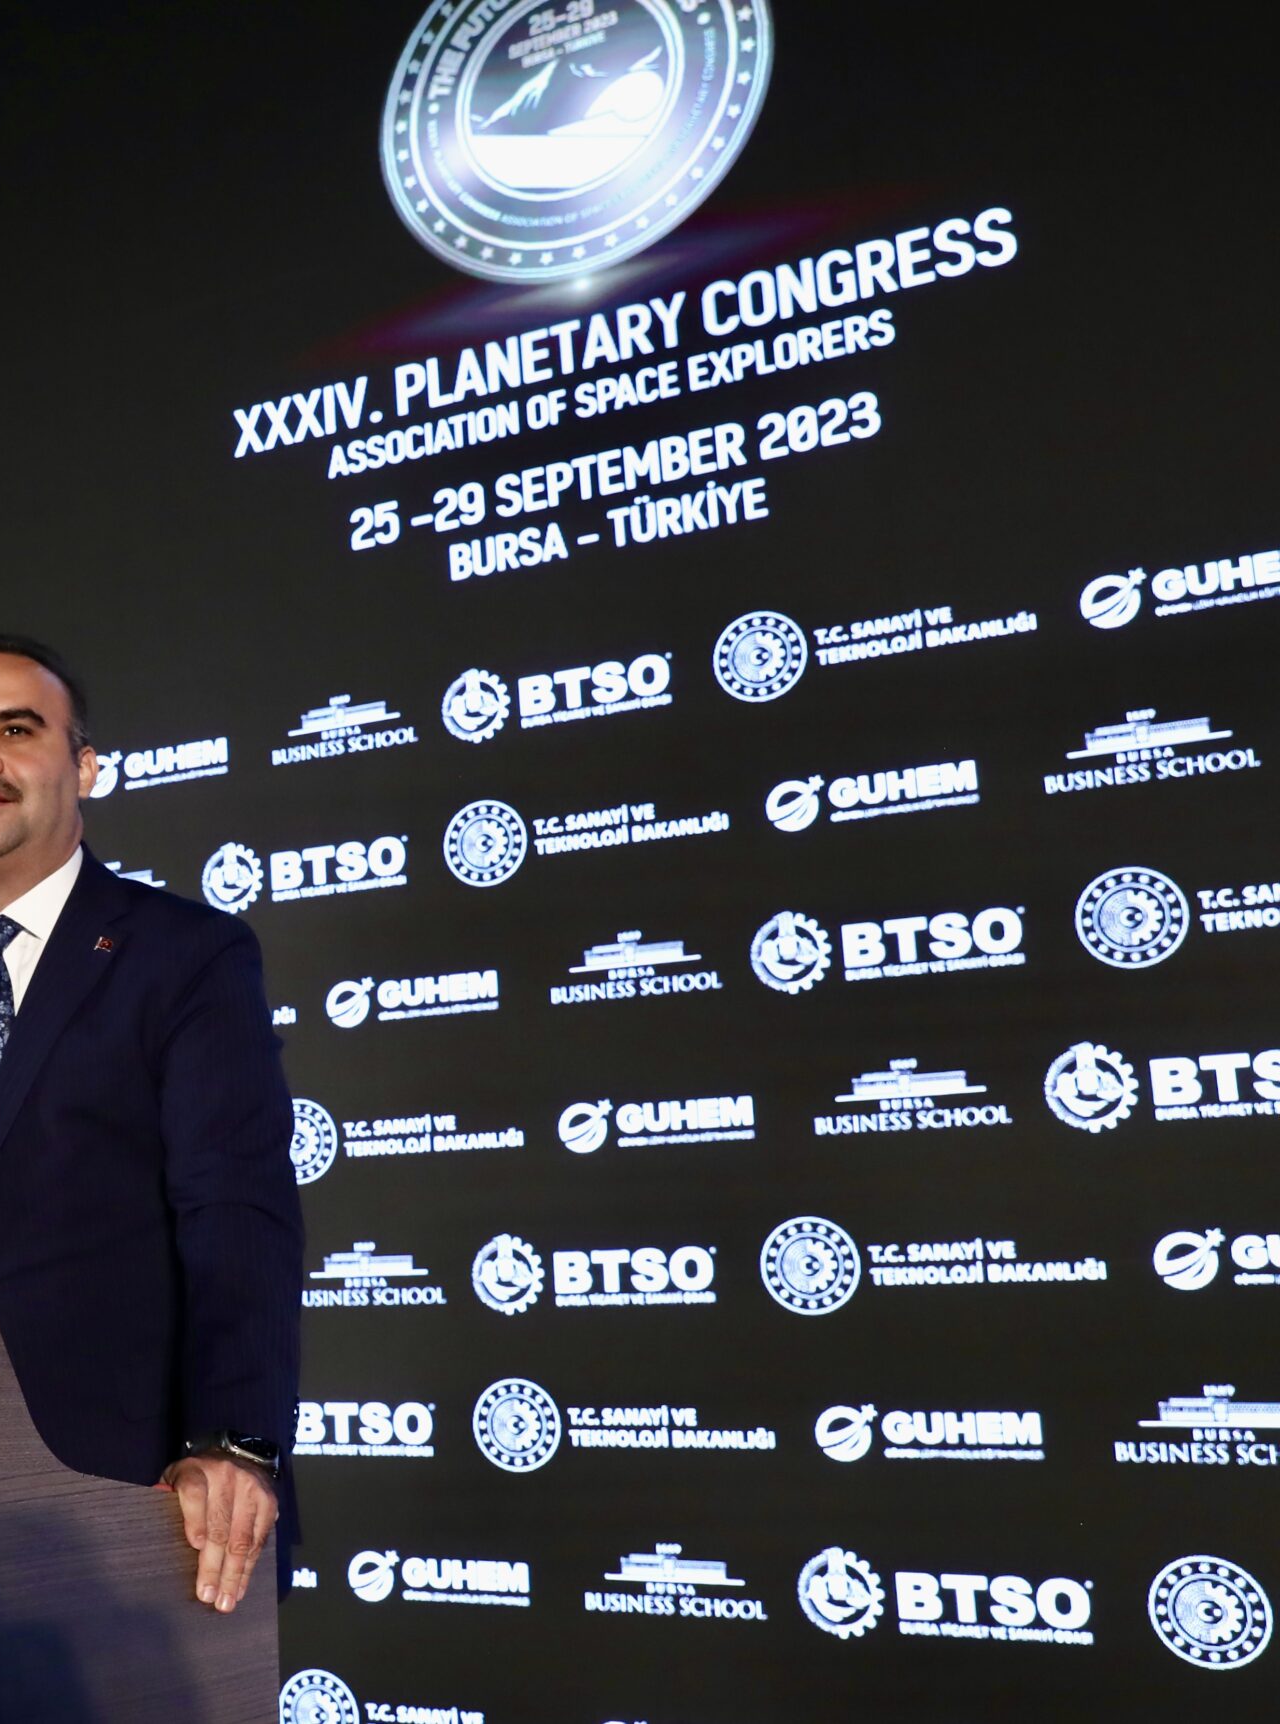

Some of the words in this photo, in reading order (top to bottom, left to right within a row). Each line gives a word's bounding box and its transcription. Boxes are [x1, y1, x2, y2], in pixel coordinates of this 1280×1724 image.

[233, 377, 383, 458] XXXIV.
[395, 291, 686, 417] PLANETARY
[702, 207, 1019, 338] CONGRESS
[326, 404, 520, 480] ASSOCIATION
[526, 388, 567, 431] OF
[574, 362, 680, 419] SPACE
[687, 308, 895, 393] EXPLORERS
[349, 499, 400, 552] 25
[495, 421, 746, 519] SEPTEMBER
[758, 391, 882, 463] 2023
[448, 522, 568, 582] BURSA
[607, 478, 770, 548] TÜRKİYE
[1151, 549, 1280, 602] GUHE
[814, 625, 849, 645] T.C.
[851, 609, 922, 640] SANAYİ
[924, 606, 952, 626] VE
[815, 630, 923, 666] TEKNOLOJİ
[925, 611, 1038, 648] BAKANLIĞI
[518, 654, 671, 718] BTSO
[124, 736, 229, 779] GUHEM
[272, 737, 346, 766] BUSINESS
[348, 726, 419, 754] SCHOOL
[1116, 746, 1175, 764] BURSA
[828, 759, 979, 808] GUHEM
[1044, 763, 1151, 795] BUSINESS
[1155, 748, 1262, 780] SCHOOL
[533, 816, 564, 836] T.C.
[565, 804, 629, 832] SANAYİ
[630, 803, 656, 822] VE
[534, 825, 629, 855] TEKNOLOJİ
[632, 811, 730, 843] BAKANLIĞI
[270, 836, 407, 892] BTSO
[1197, 887, 1241, 910] T.C.
[841, 907, 1023, 969] BTSO
[1200, 907, 1280, 933] TEKNO
[377, 970, 498, 1009] GUHEM
[550, 977, 635, 1006] BUSINESS
[640, 971, 723, 998] SCHOOL
[608, 966, 656, 980] BURSA
[1148, 1048, 1280, 1106] BTS
[616, 1095, 755, 1134] GUHEM
[814, 1111, 912, 1136] BUSINESS
[917, 1105, 1013, 1129] SCHOOL
[879, 1097, 935, 1112] BURSA
[342, 1119, 372, 1138] T.C.
[433, 1114, 456, 1131] VE
[433, 1126, 525, 1153] BAKANLIĞI
[867, 1243, 905, 1263] T.C.
[907, 1237, 985, 1262] SANAYİ
[986, 1240, 1016, 1260] VE
[552, 1245, 715, 1295] BTSO
[869, 1260, 985, 1286] TEKNOLOJİ
[987, 1257, 1108, 1283] BAKANLIĞI
[301, 1289, 369, 1308] USINESS
[372, 1286, 448, 1306] SCHOOL
[295, 1401, 434, 1446] BTSO
[567, 1407, 600, 1426] T.C.
[601, 1404, 669, 1427] SANAYİ
[671, 1407, 697, 1427] VE
[881, 1411, 1043, 1446] GUHEM
[568, 1426, 669, 1449] TEKNOLOJİ
[671, 1427, 776, 1450] BAKANLIĞI
[1114, 1441, 1230, 1465] BUSINESS
[1192, 1428, 1256, 1442] BURSA
[401, 1557, 530, 1594] GUHEM
[584, 1591, 675, 1617] BUSINESS
[679, 1596, 769, 1620] SCHOOL
[894, 1571, 1091, 1630] BTSO
[364, 1702, 396, 1722] T.C.
